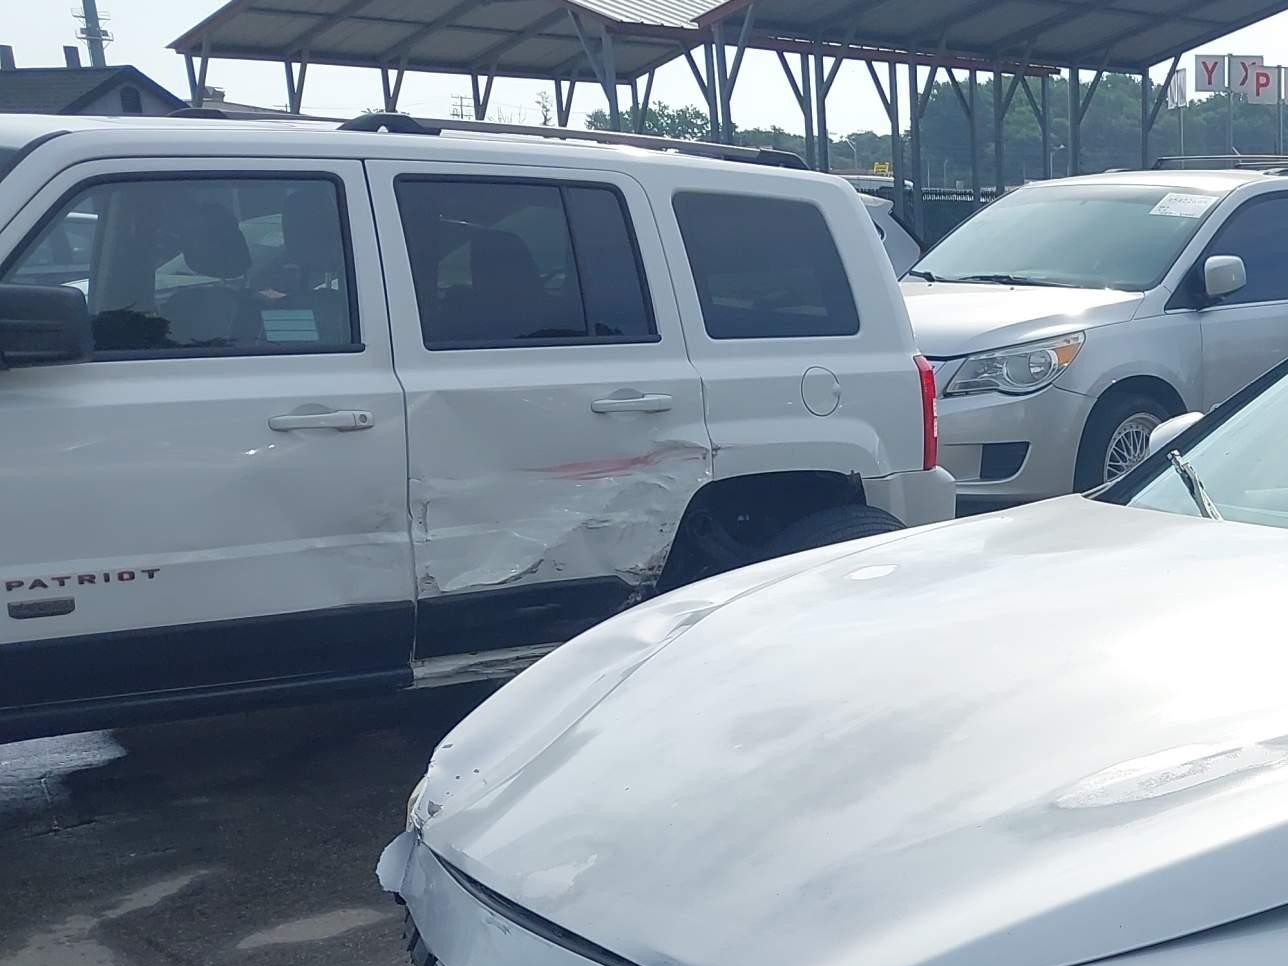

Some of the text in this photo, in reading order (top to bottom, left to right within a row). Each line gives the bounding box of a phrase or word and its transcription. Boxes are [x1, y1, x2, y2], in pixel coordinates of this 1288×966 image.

[1201, 61, 1218, 85] Y
[1255, 71, 1271, 97] P
[5, 568, 161, 592] PATRIOT
